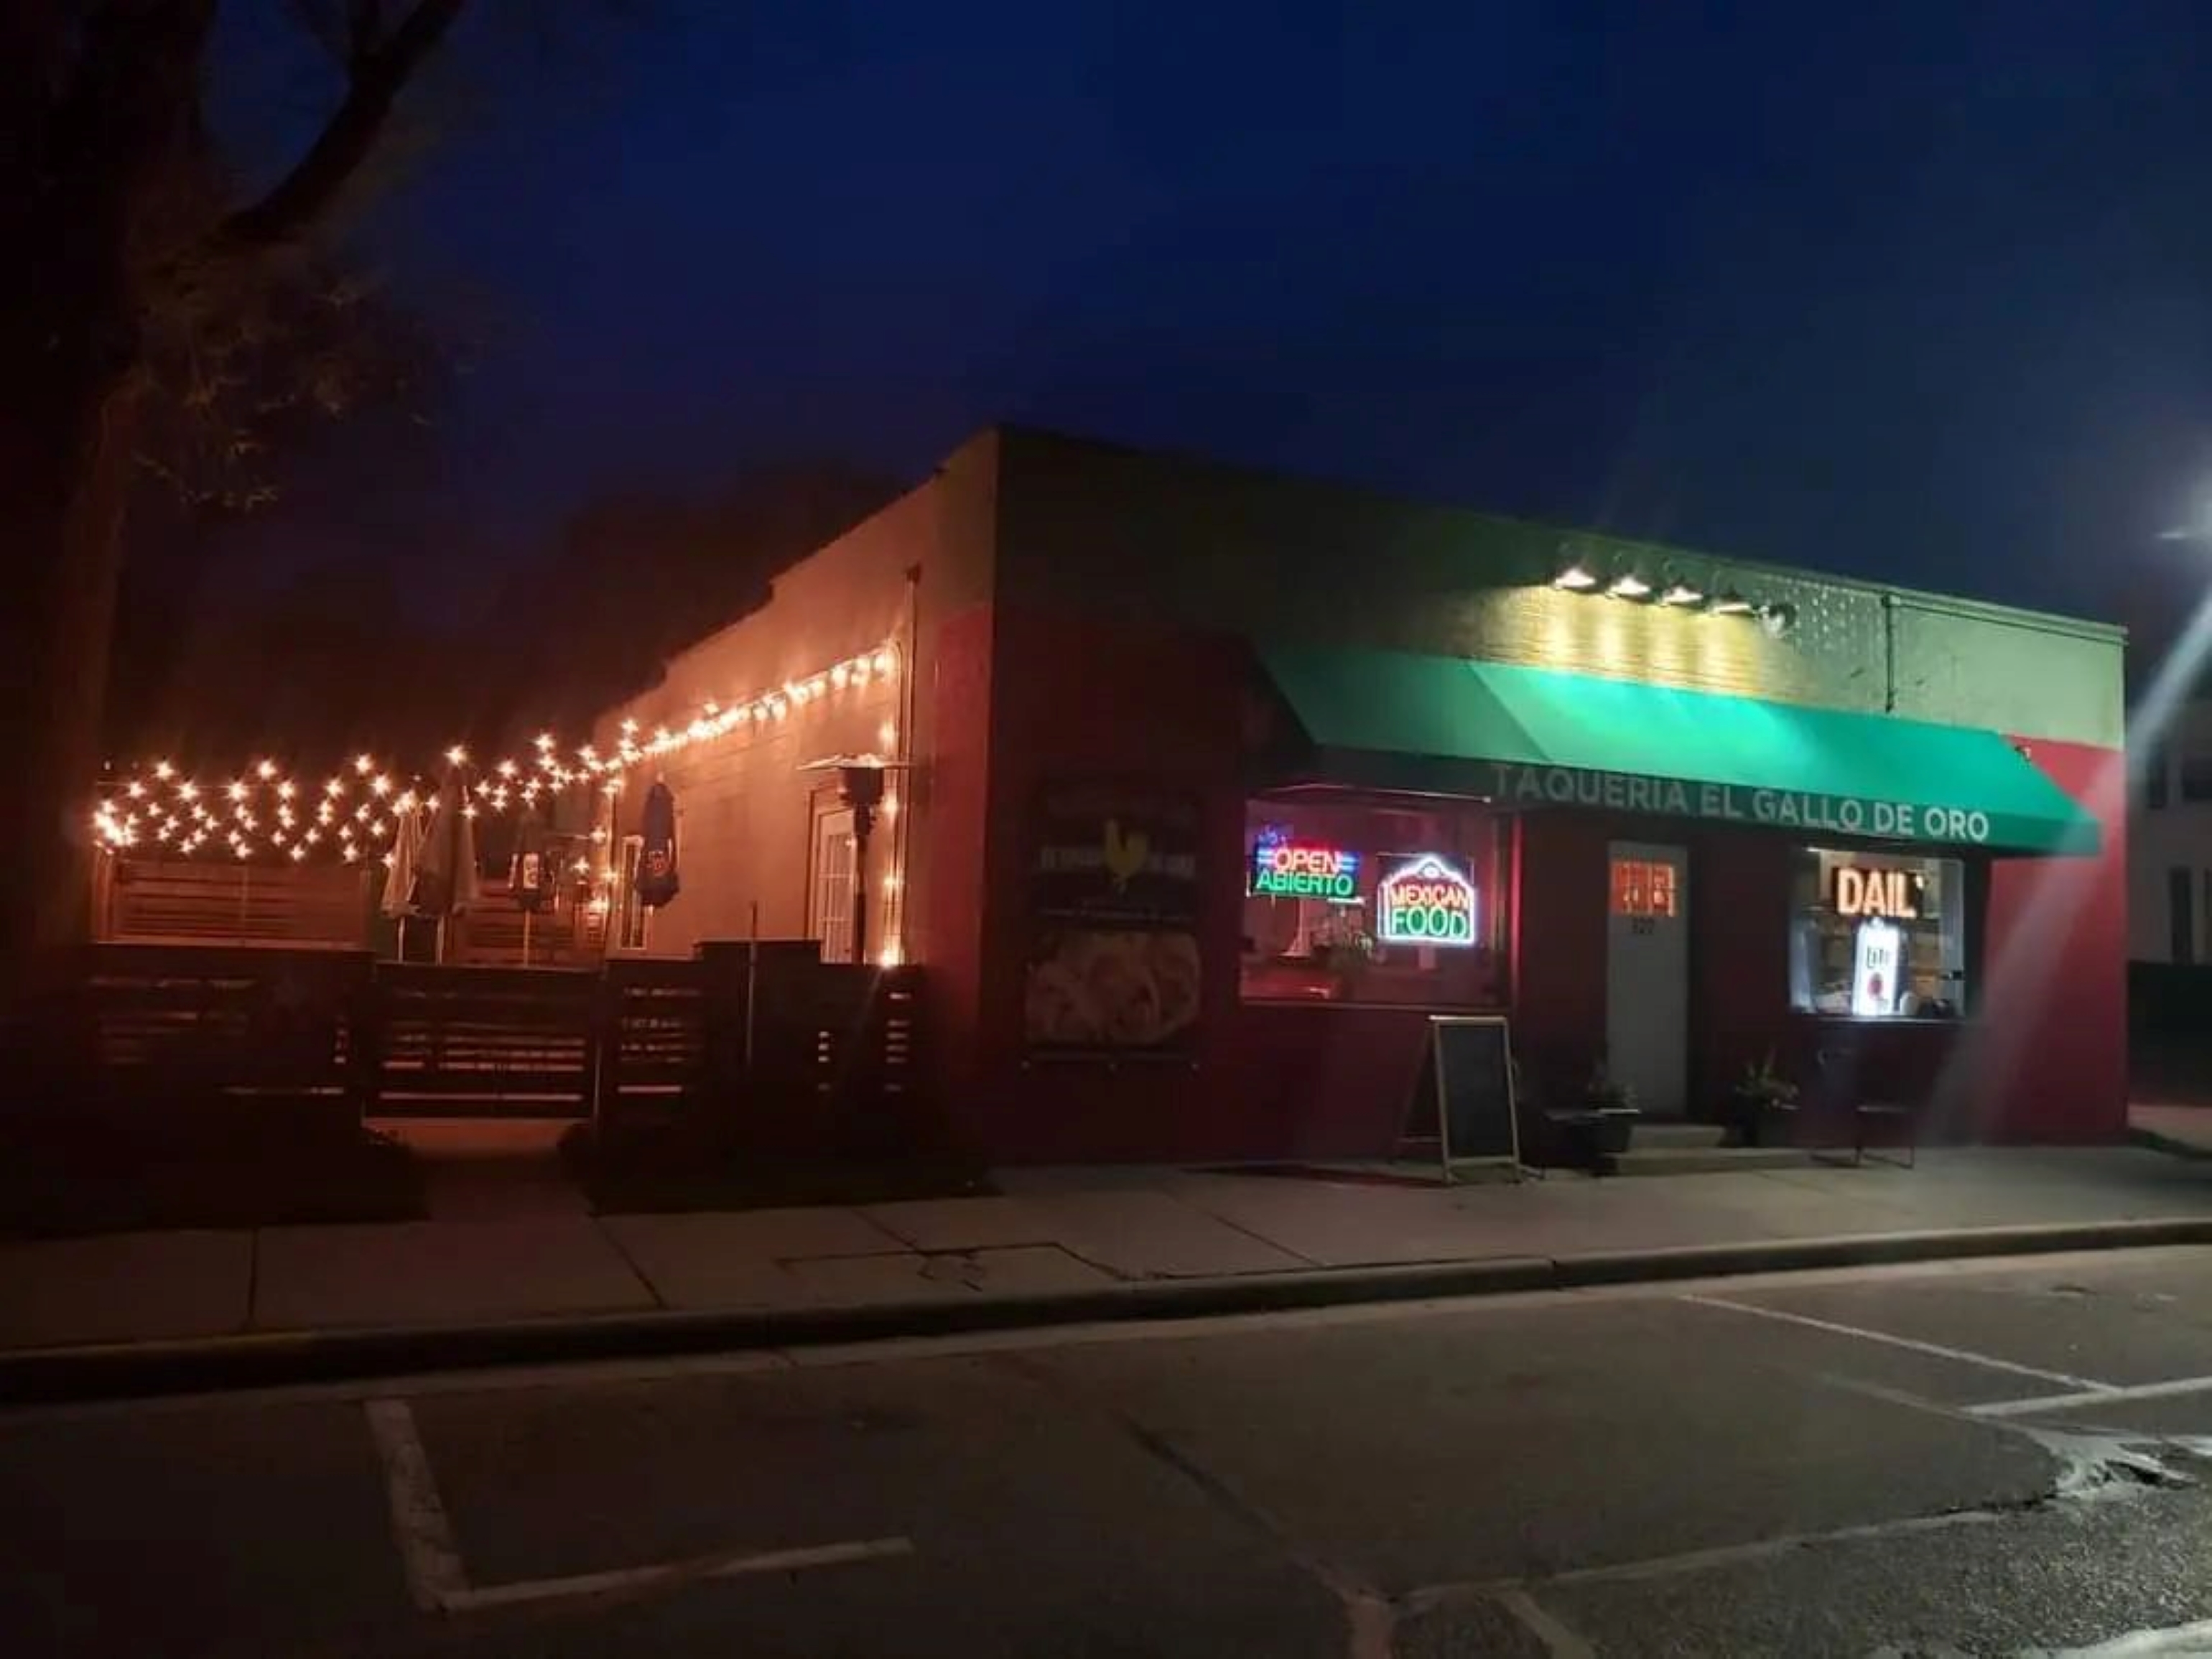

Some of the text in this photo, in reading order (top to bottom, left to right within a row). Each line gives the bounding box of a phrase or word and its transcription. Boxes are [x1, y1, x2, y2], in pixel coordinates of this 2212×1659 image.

[1490, 763, 1989, 842] TAQUERIA EL GALLO DE ORO
[1275, 848, 1343, 874] OPEN
[1256, 868, 1354, 896] ABIERTO
[1390, 883, 1470, 911] MEXICAN
[1392, 907, 1467, 938] FOOD
